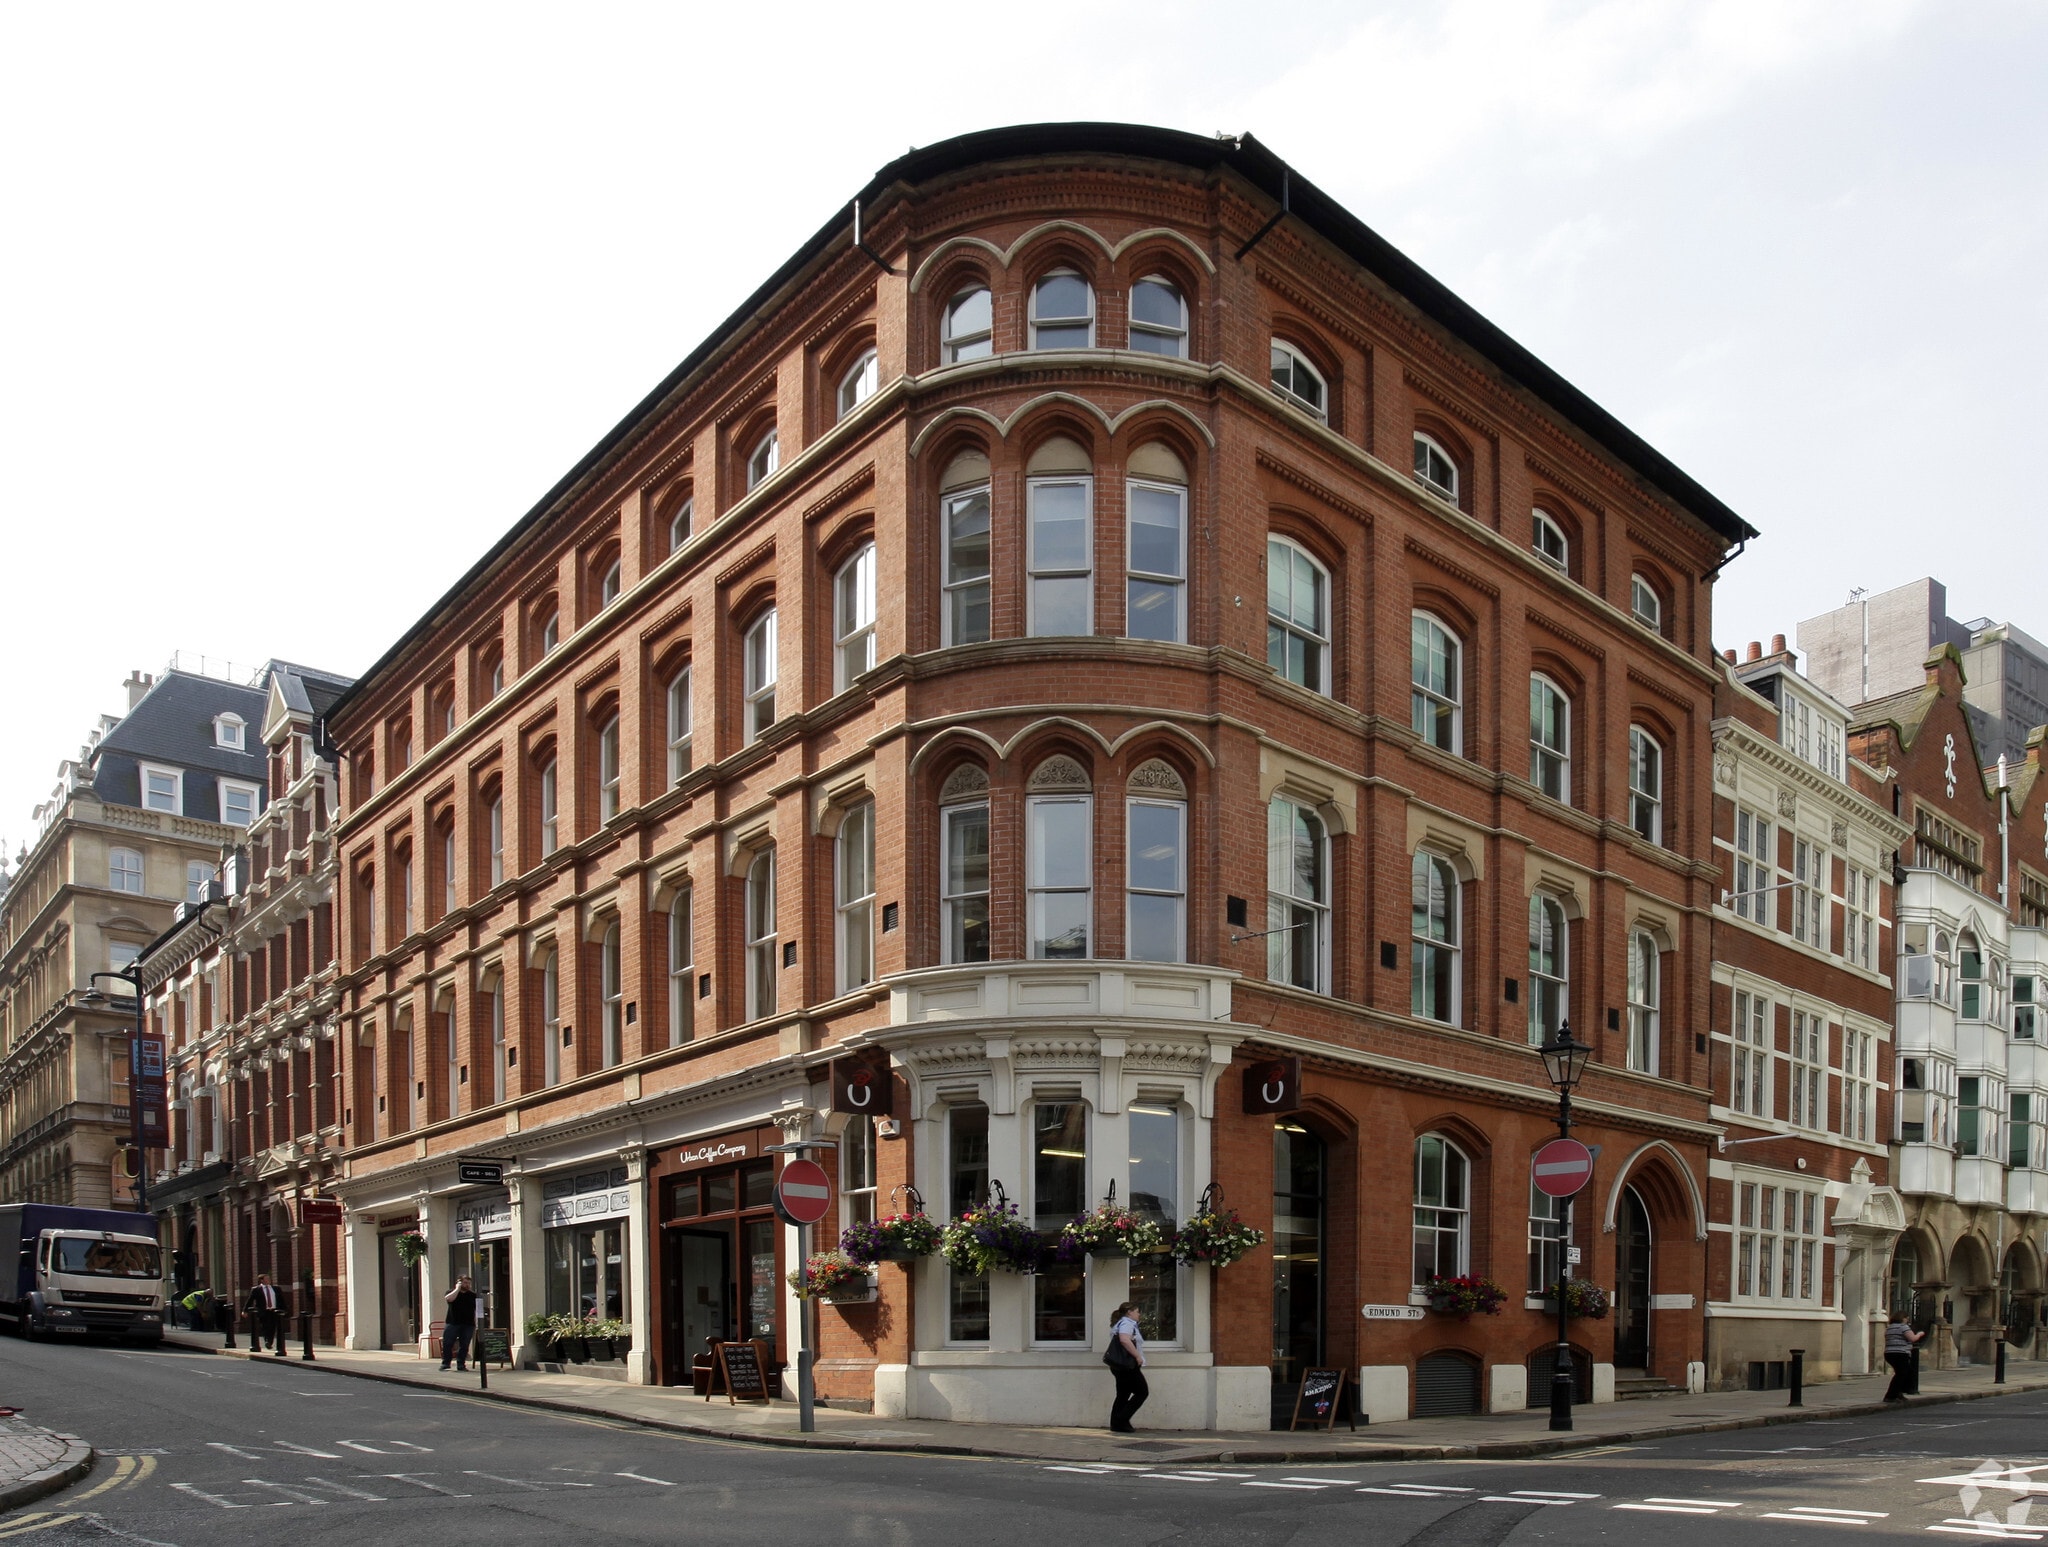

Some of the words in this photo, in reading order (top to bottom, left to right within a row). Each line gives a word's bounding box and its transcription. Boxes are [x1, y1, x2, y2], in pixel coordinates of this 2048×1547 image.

[680, 1151, 699, 1164] Urban
[698, 1147, 718, 1163] Coffee
[717, 1143, 746, 1158] Company
[582, 1199, 602, 1210] BAKERY
[1368, 1308, 1400, 1318] EDMUND
[1304, 1383, 1333, 1397] AMAZING
